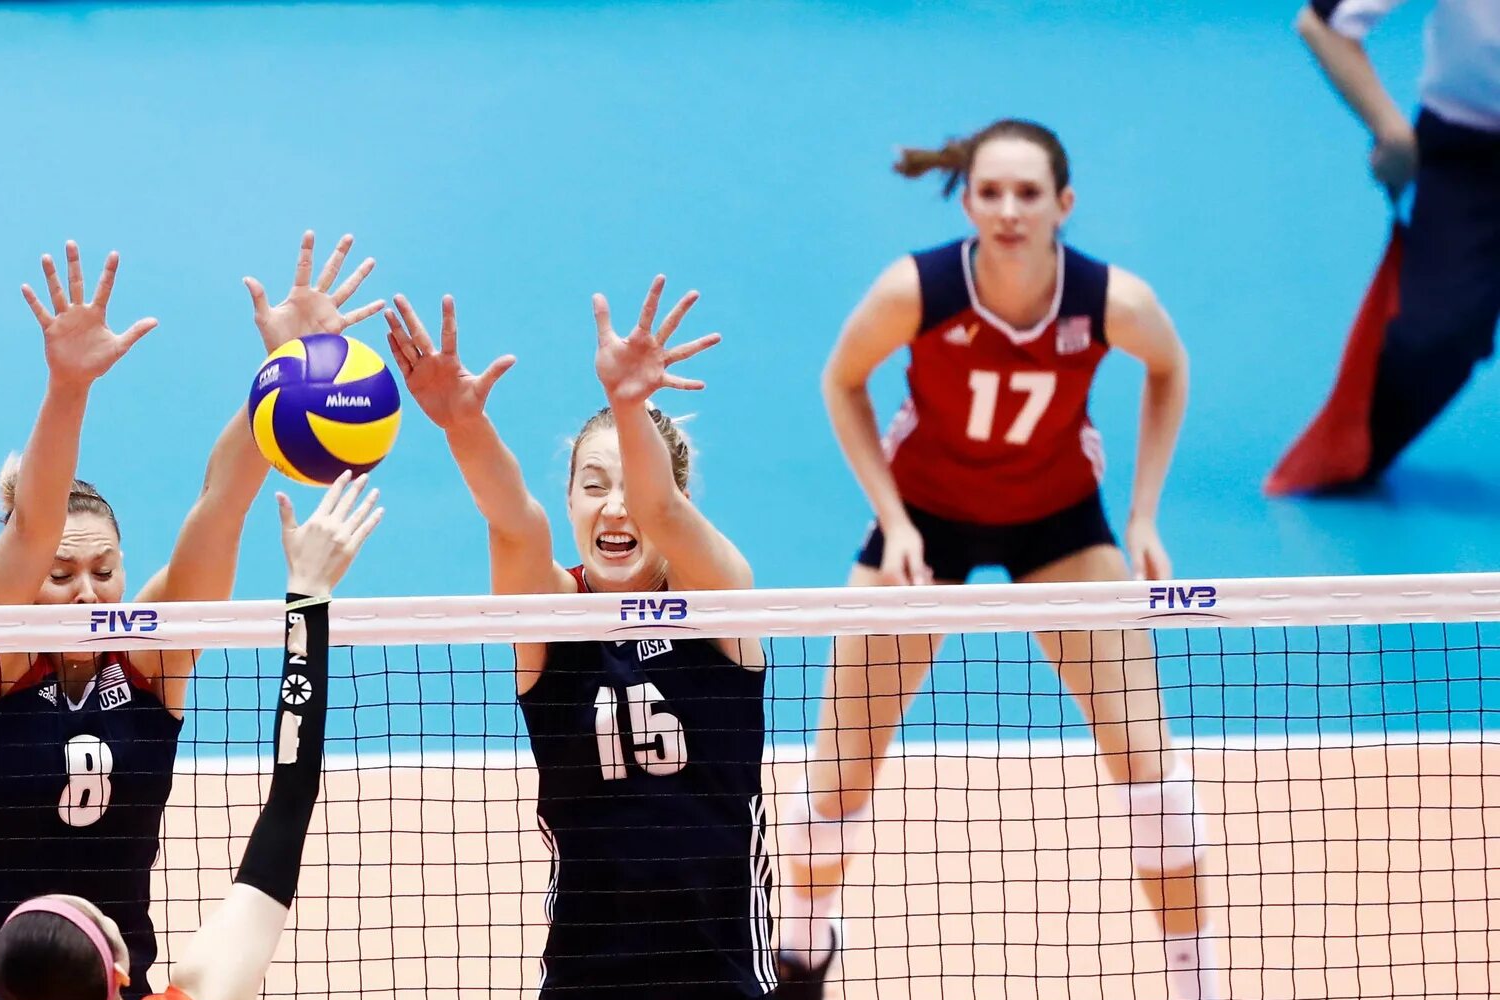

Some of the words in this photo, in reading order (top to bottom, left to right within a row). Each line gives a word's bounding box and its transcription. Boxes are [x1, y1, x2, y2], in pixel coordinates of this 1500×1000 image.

[966, 369, 1057, 445] 17
[1150, 587, 1216, 609] FIVB
[621, 599, 687, 620] FIVB
[90, 611, 157, 633] FIVB
[640, 639, 667, 657] USA
[100, 687, 128, 709] USA
[594, 683, 687, 780] 15
[58, 734, 113, 827] 8
